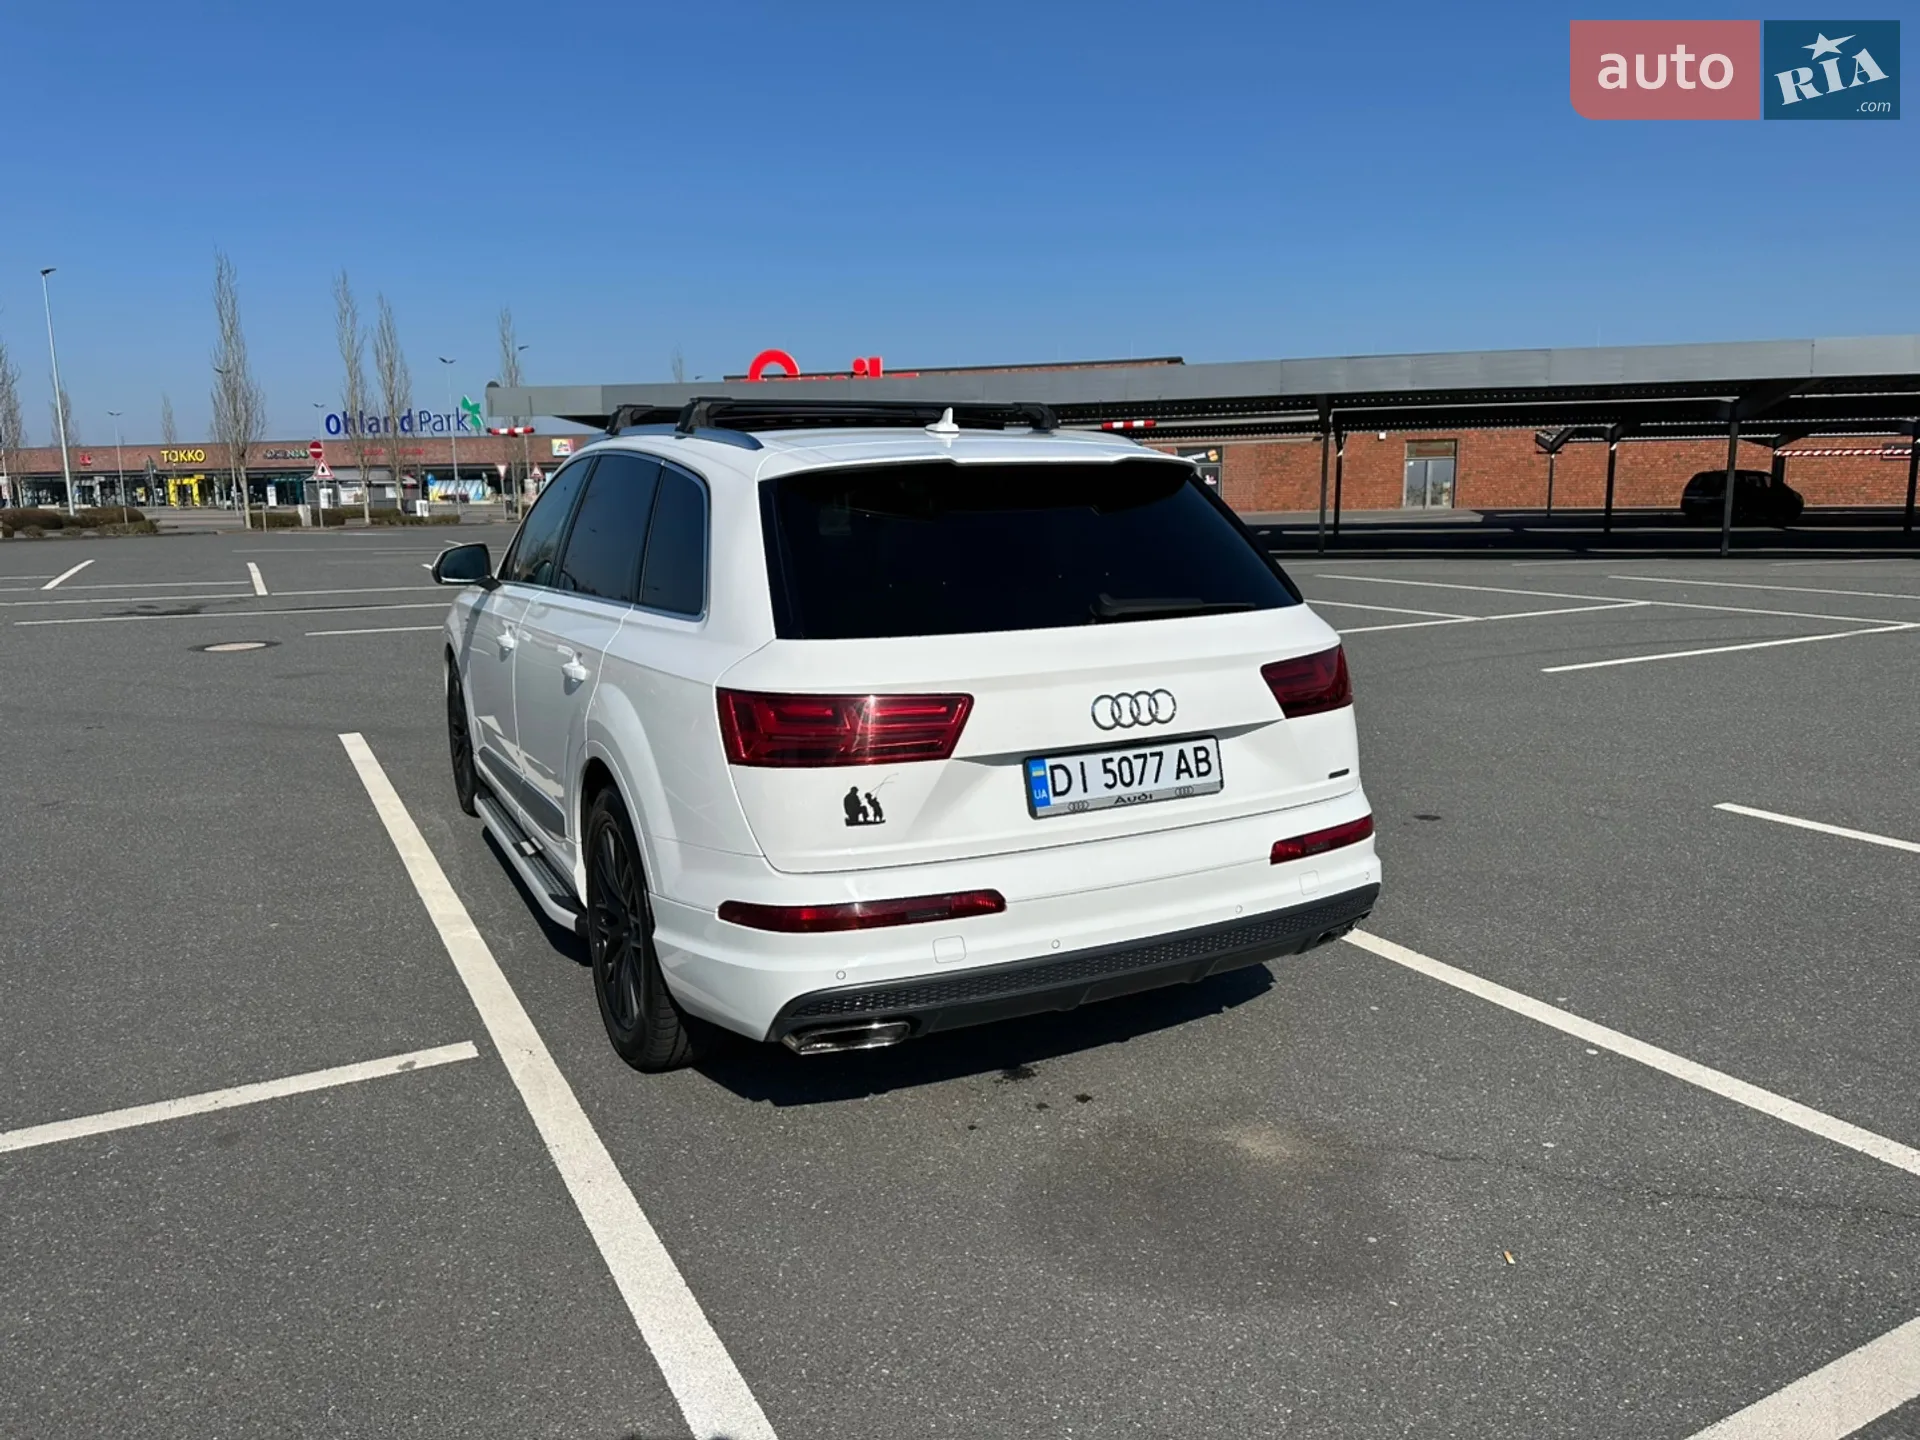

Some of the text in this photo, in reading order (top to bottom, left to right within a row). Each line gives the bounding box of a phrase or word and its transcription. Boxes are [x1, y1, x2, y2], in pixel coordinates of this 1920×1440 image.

[1049, 746, 1212, 798] DI 5077 AB
[1034, 788, 1048, 800] UA
[1114, 793, 1153, 805] Audi
